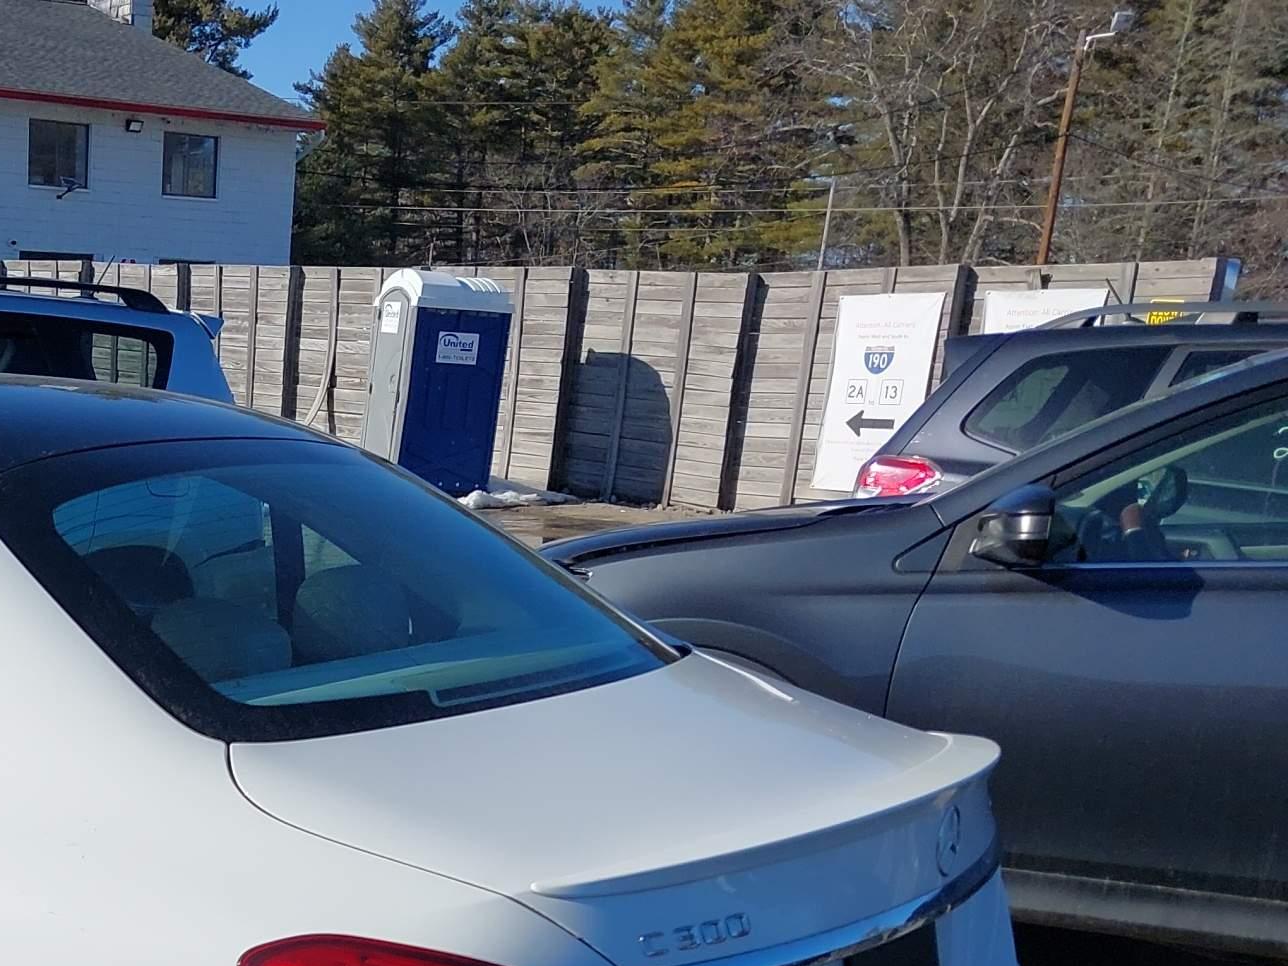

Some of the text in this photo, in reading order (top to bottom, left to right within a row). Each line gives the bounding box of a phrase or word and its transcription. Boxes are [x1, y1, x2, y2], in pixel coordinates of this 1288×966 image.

[443, 338, 474, 349] United
[868, 353, 888, 369] 190
[847, 384, 864, 399] 2A
[884, 385, 898, 399] 13
[638, 912, 751, 957] C 300
